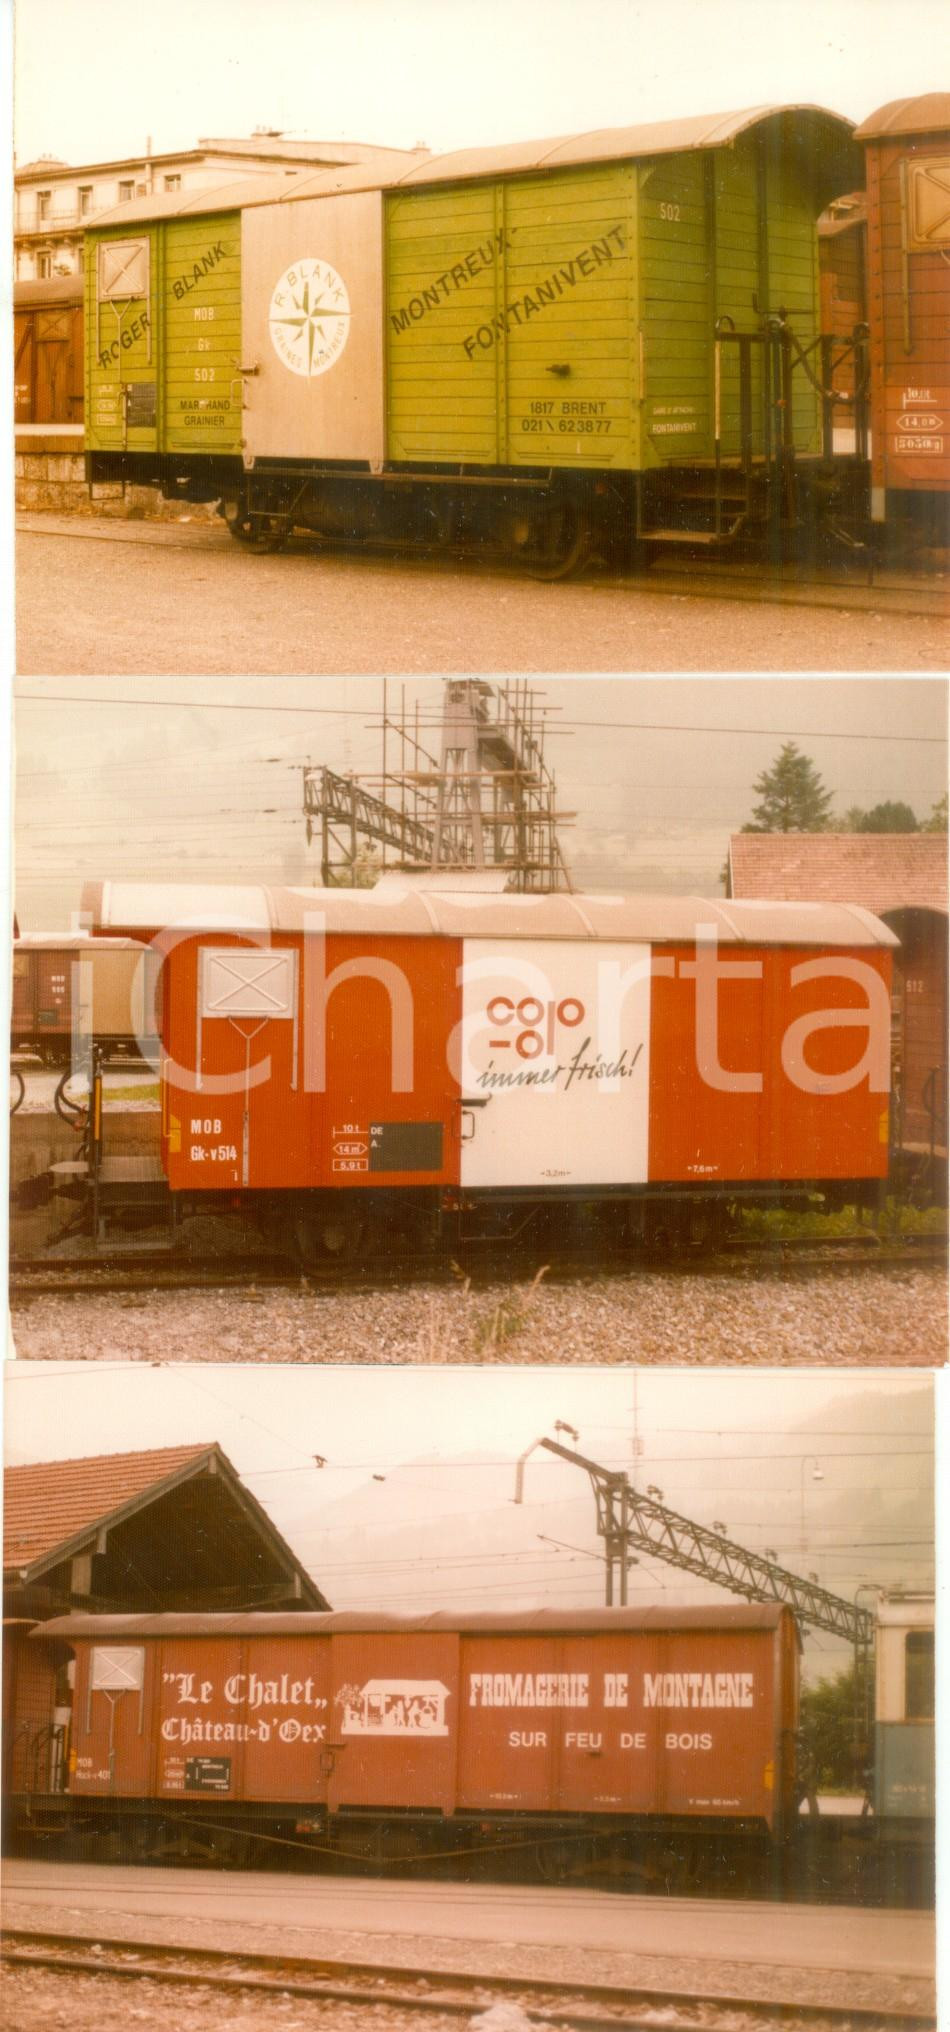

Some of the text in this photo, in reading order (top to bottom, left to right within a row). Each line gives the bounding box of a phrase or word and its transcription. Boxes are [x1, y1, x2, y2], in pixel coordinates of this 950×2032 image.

[659, 203, 681, 222] 502
[171, 241, 226, 301] BLANK
[286, 264, 345, 304] BLANK
[390, 228, 512, 335] MONTREUX
[461, 225, 628, 361] FONTANIVENT
[193, 307, 215, 320] MOB
[193, 368, 216, 382] 502
[180, 400, 231, 411] MARHAND
[530, 401, 606, 415] 1817 BRENT
[184, 416, 225, 426] GRAINIER
[521, 420, 543, 432] 021
[652, 422, 697, 433] FONTANIVENT
[476, 1036, 644, 1091] immer frisch!
[190, 1119, 222, 1135] MOB
[370, 1126, 384, 1135] DE
[469, 1673, 753, 1708] FROMAGERIE DE MONTAGNE
[508, 1731, 713, 1751] SUR FEU DE BOIS
